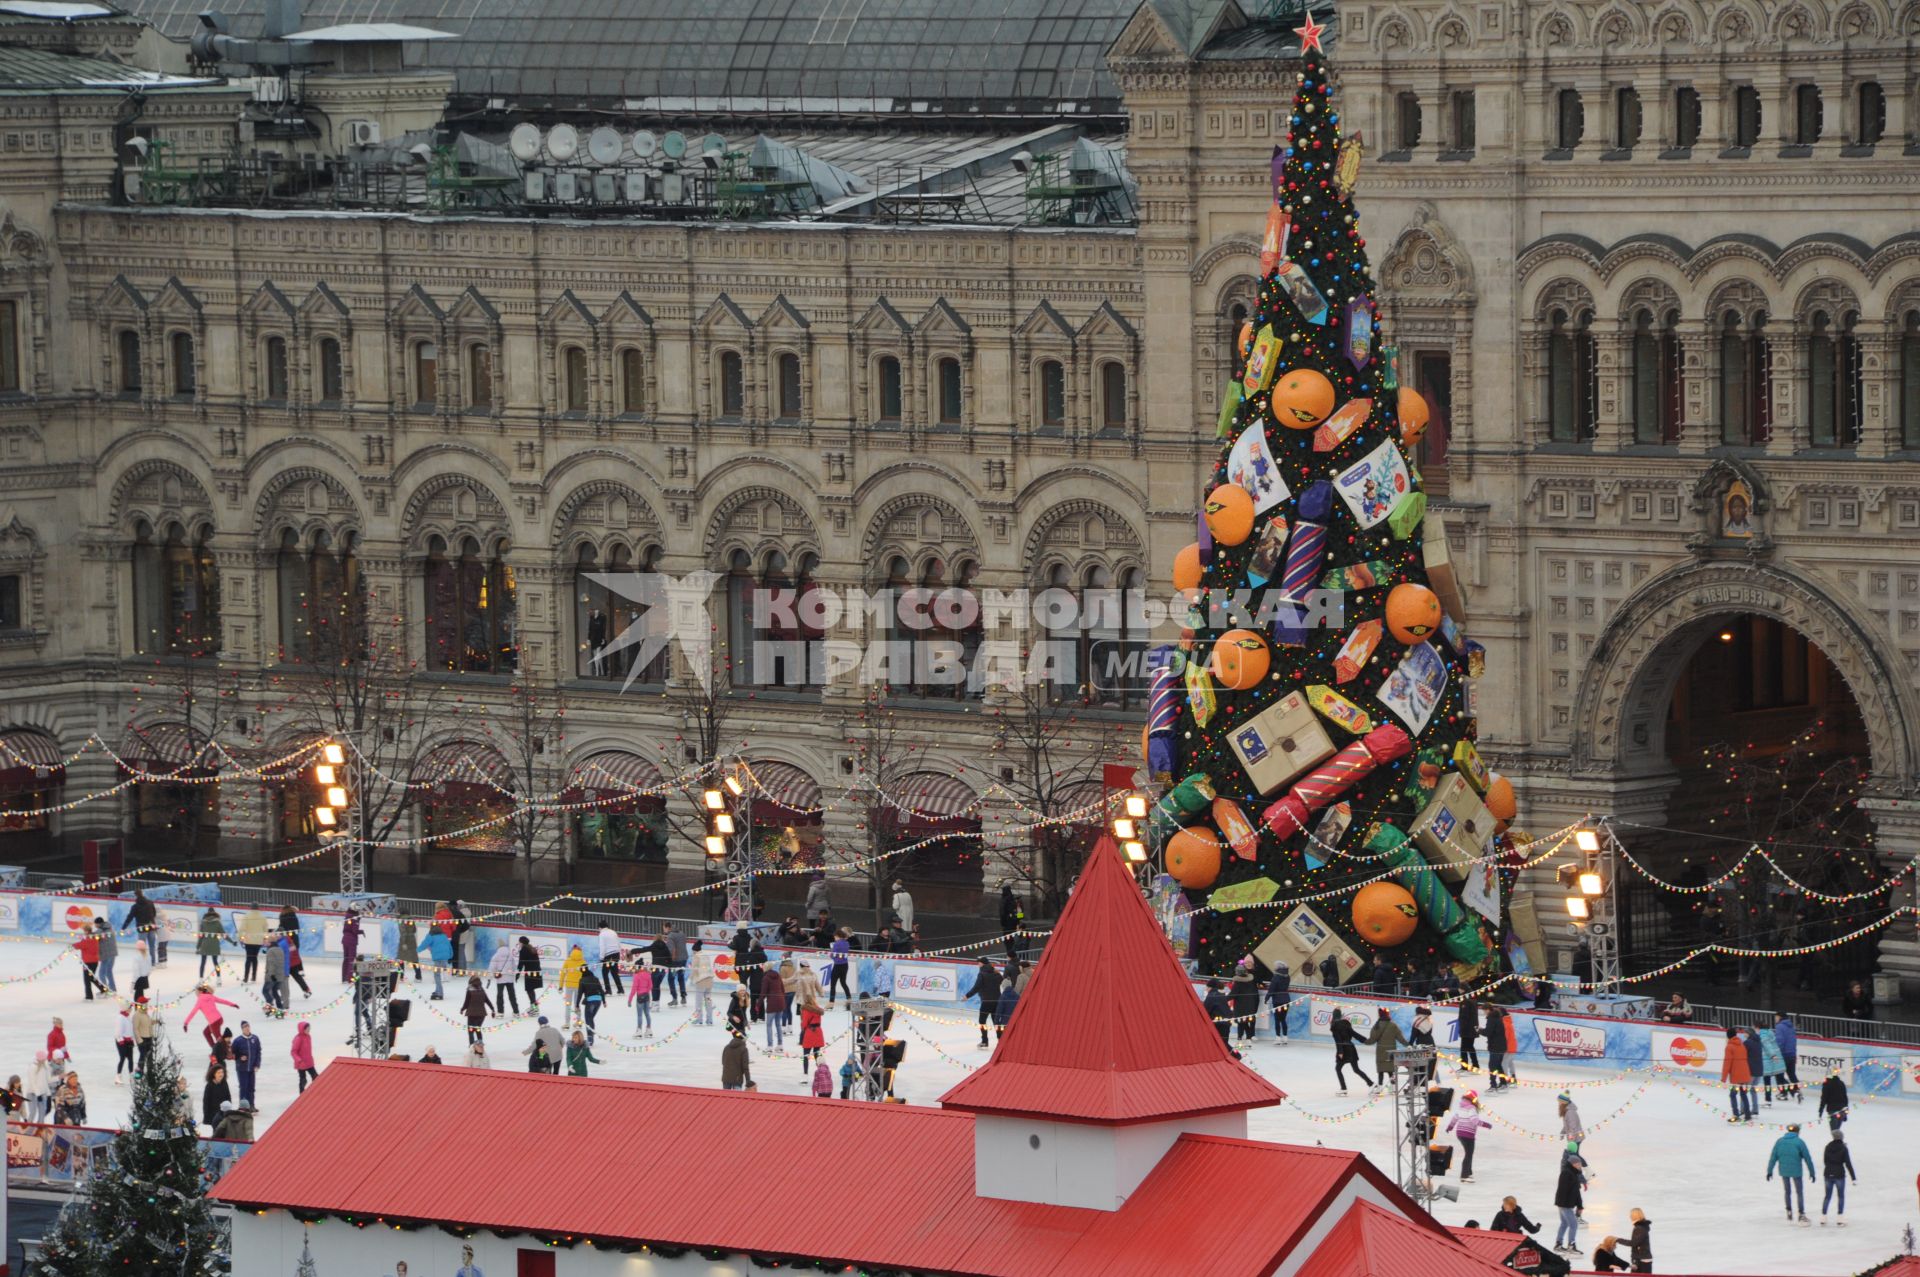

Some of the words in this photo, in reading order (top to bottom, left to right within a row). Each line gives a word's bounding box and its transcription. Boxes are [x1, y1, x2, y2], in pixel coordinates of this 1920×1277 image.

[1545, 1027, 1572, 1043] BOSCO
[1576, 1036, 1602, 1052] fresh
[1799, 1054, 1845, 1068] TISSOT
